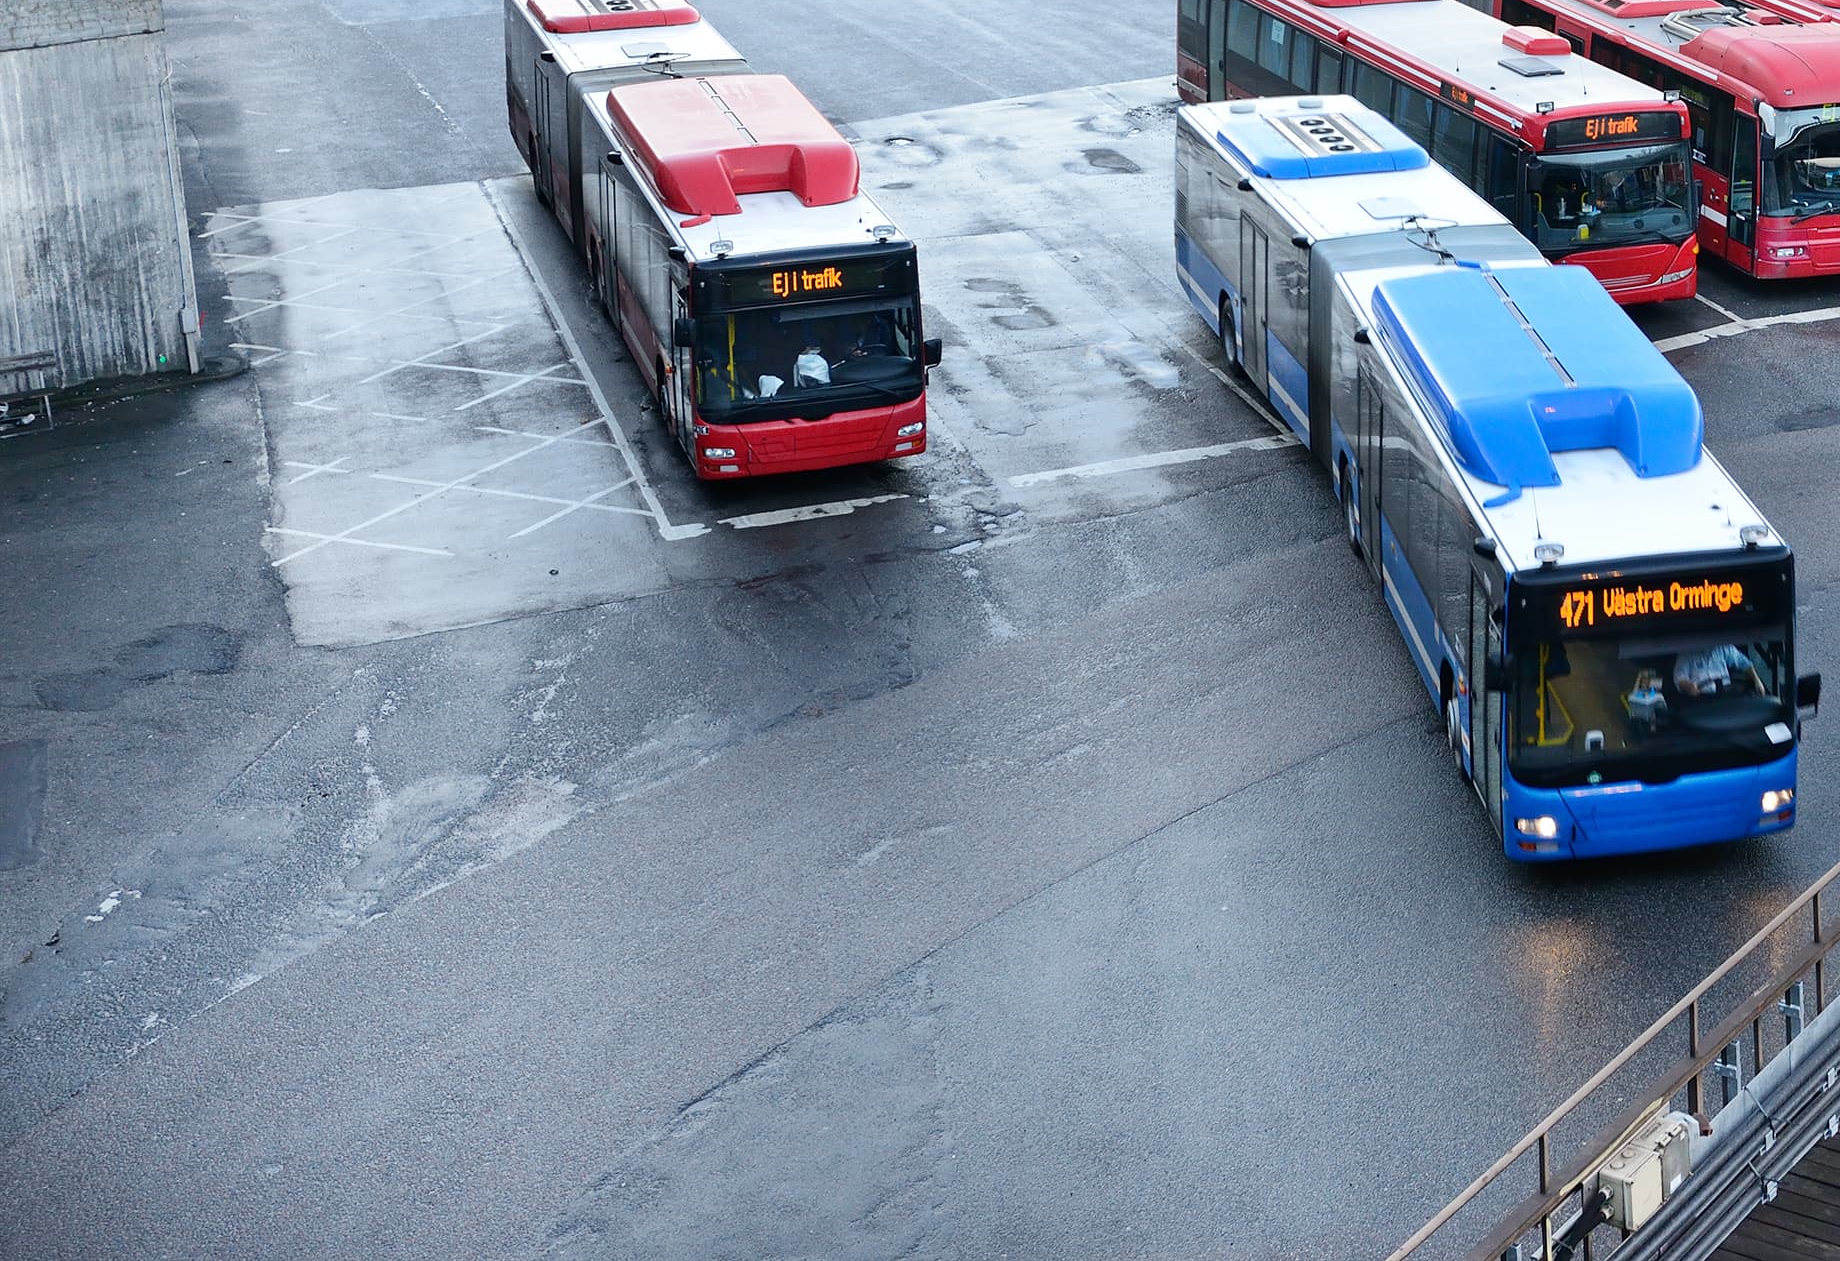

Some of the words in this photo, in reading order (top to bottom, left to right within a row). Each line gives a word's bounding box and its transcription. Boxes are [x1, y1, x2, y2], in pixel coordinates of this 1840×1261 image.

[1586, 119, 1599, 140] Ej
[1608, 115, 1639, 135] trafik
[772, 271, 789, 297] Ej
[801, 267, 843, 290] trafik
[1560, 590, 1595, 628] 471
[1602, 585, 1665, 618] Västra
[1669, 579, 1743, 613] Orminge
